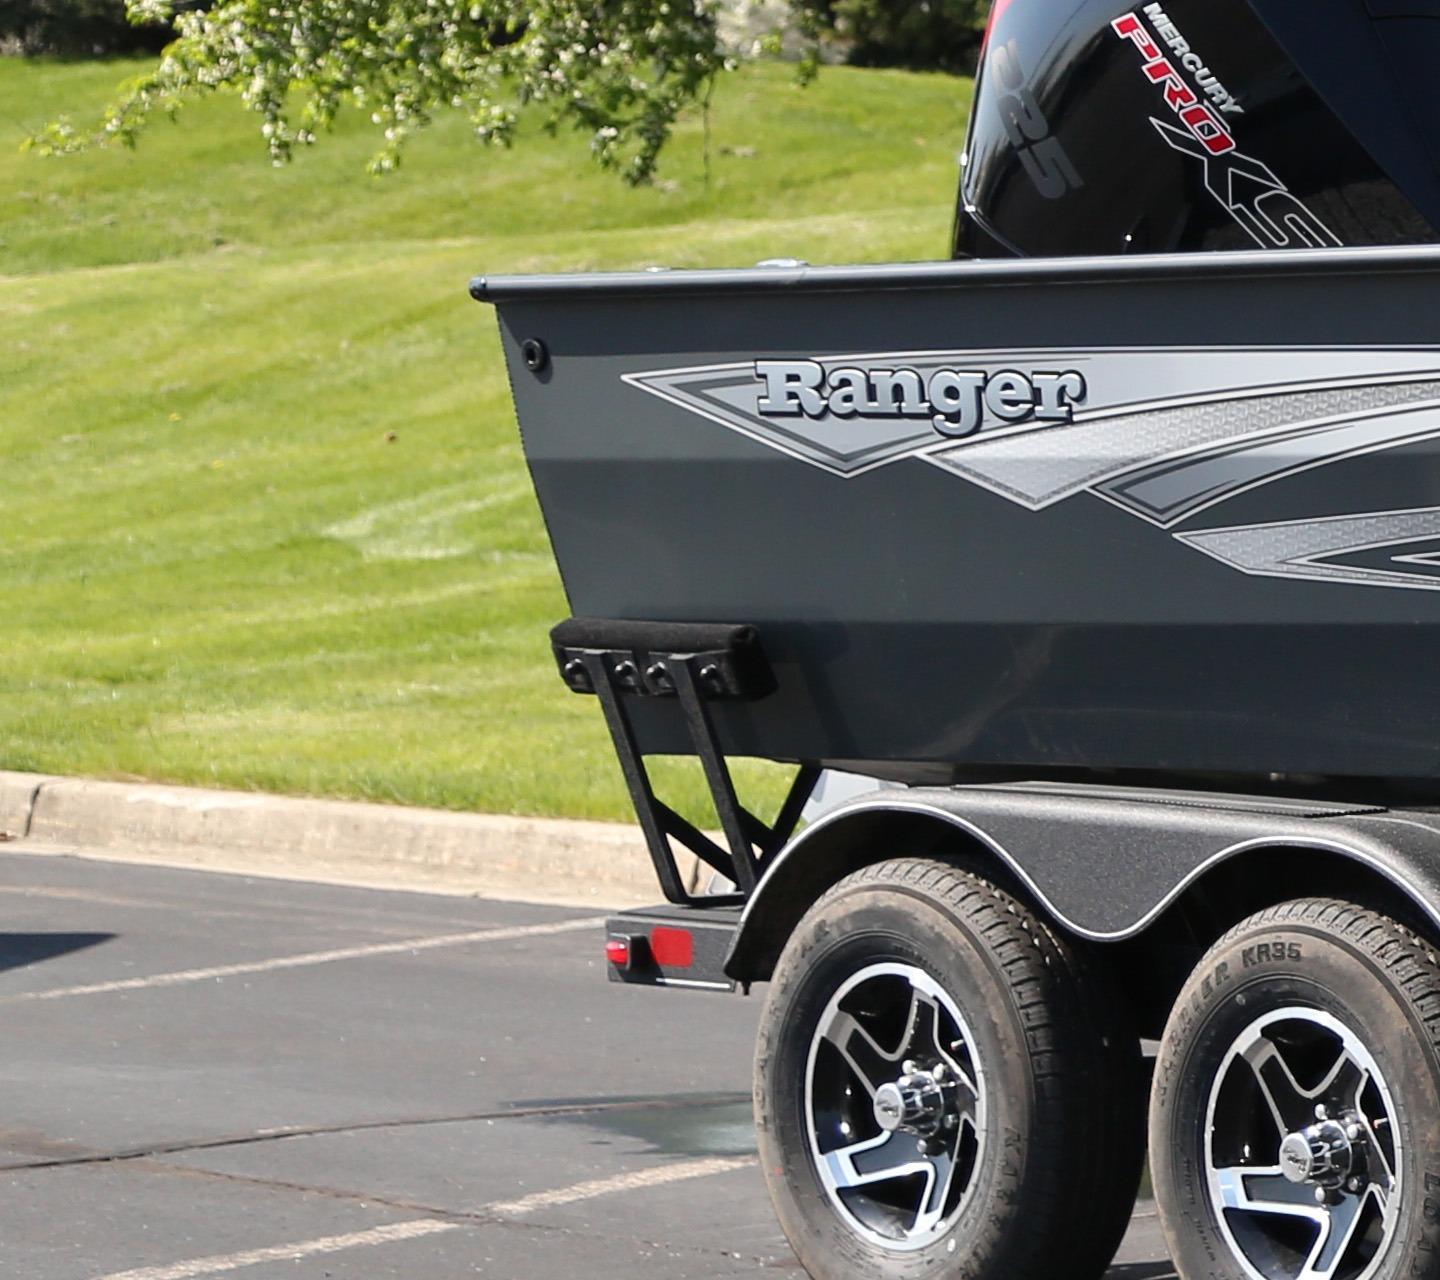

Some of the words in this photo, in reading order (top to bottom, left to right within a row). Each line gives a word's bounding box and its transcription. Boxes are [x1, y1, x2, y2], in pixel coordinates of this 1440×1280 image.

[1111, 12, 1236, 155] PRO
[1143, 2, 1245, 115] MERCURY
[991, 39, 1085, 200] 225
[755, 358, 1087, 438] Ranger
[1240, 941, 1303, 970] KR35
